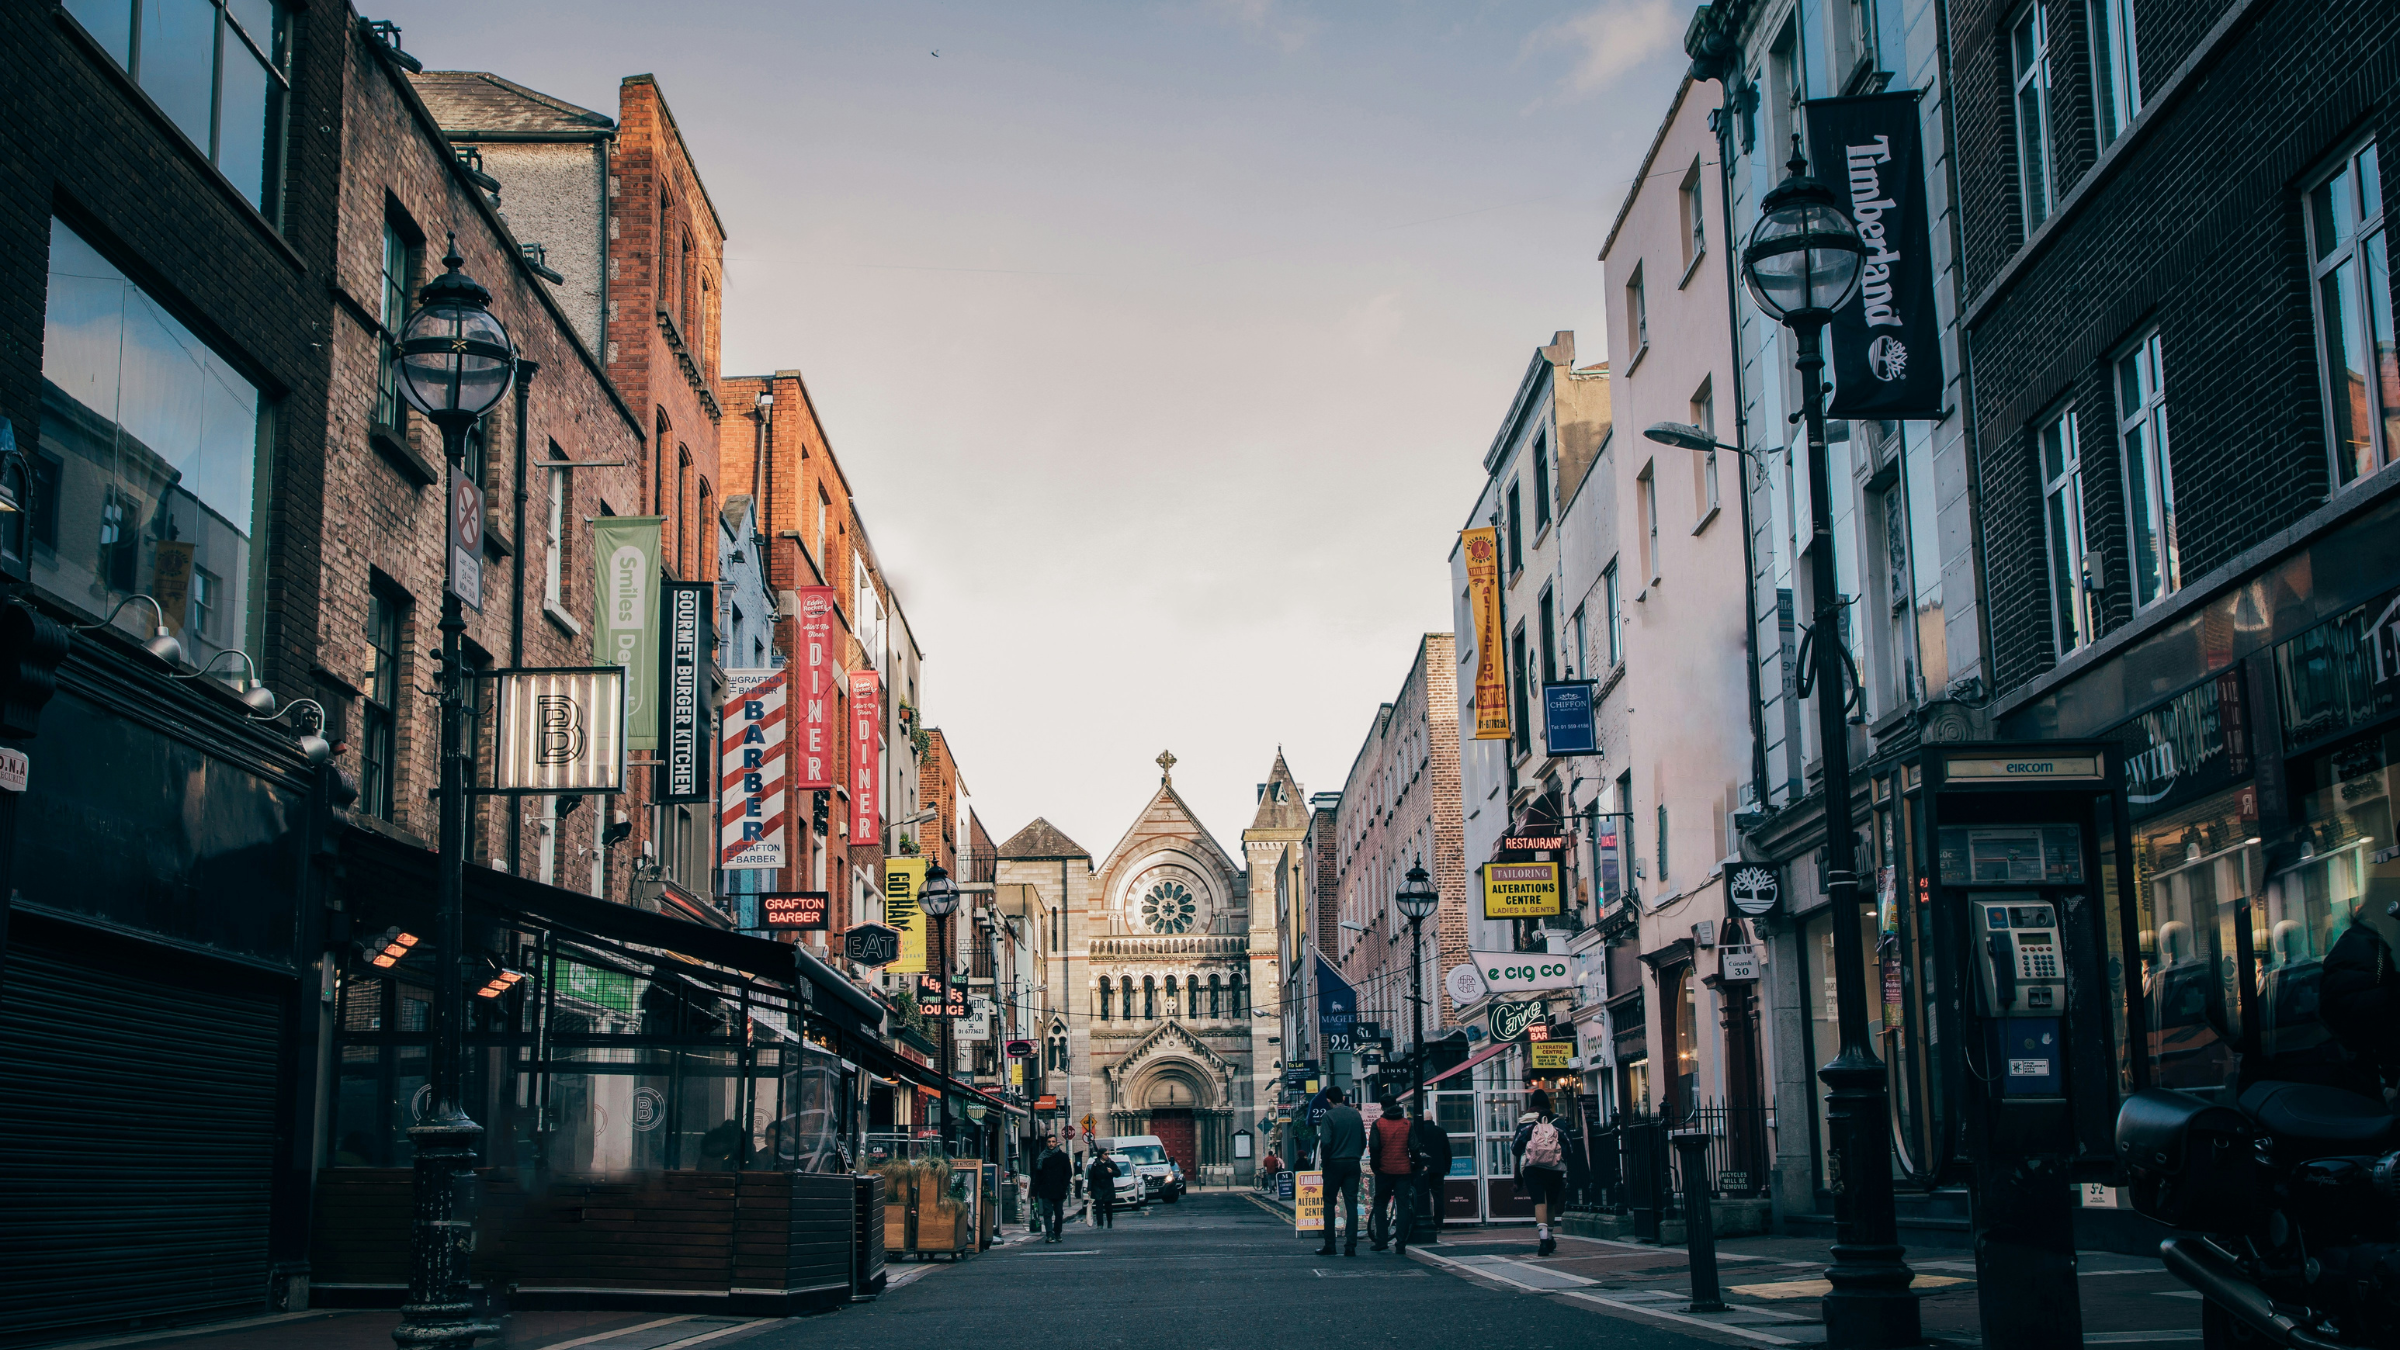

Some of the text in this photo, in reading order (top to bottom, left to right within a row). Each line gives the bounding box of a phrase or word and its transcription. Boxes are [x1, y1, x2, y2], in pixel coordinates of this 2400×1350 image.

[1845, 134, 1903, 328] Timberland
[617, 556, 638, 622] Smiles
[1482, 586, 1494, 682] ALTERATION
[737, 676, 782, 684] GRAFTON
[674, 590, 694, 796] GOURMET BURGER KITCHEN
[738, 686, 778, 695] BARBER
[1478, 688, 1504, 706] CENTRE
[1550, 700, 1587, 708] CHIFFON
[808, 643, 822, 781] DINER
[537, 694, 585, 767] B
[743, 700, 766, 842] BARBER
[858, 720, 871, 839] DINER
[735, 844, 780, 852] GRAFTON
[1506, 837, 1562, 850] RESTAURANT
[1496, 868, 1548, 878] TAILORING
[1492, 884, 1555, 894] ALTERATIONS
[764, 898, 824, 910] GRAFTON
[1506, 896, 1542, 904] CENTRE
[768, 912, 820, 922] BARBER
[849, 936, 894, 958] EAT
[1488, 964, 1566, 982] e cig co
[1734, 968, 1750, 976] 30
[952, 976, 966, 984] NES
[1321, 1015, 1354, 1023] MAGEE
[1490, 1001, 1546, 1042] Cave
[1330, 1034, 1351, 1050] 22
[1530, 1032, 1548, 1040] BAR
[636, 1096, 654, 1122] B
[1312, 1108, 1327, 1118] 22
[1298, 1198, 1323, 1206] ALTERAT
